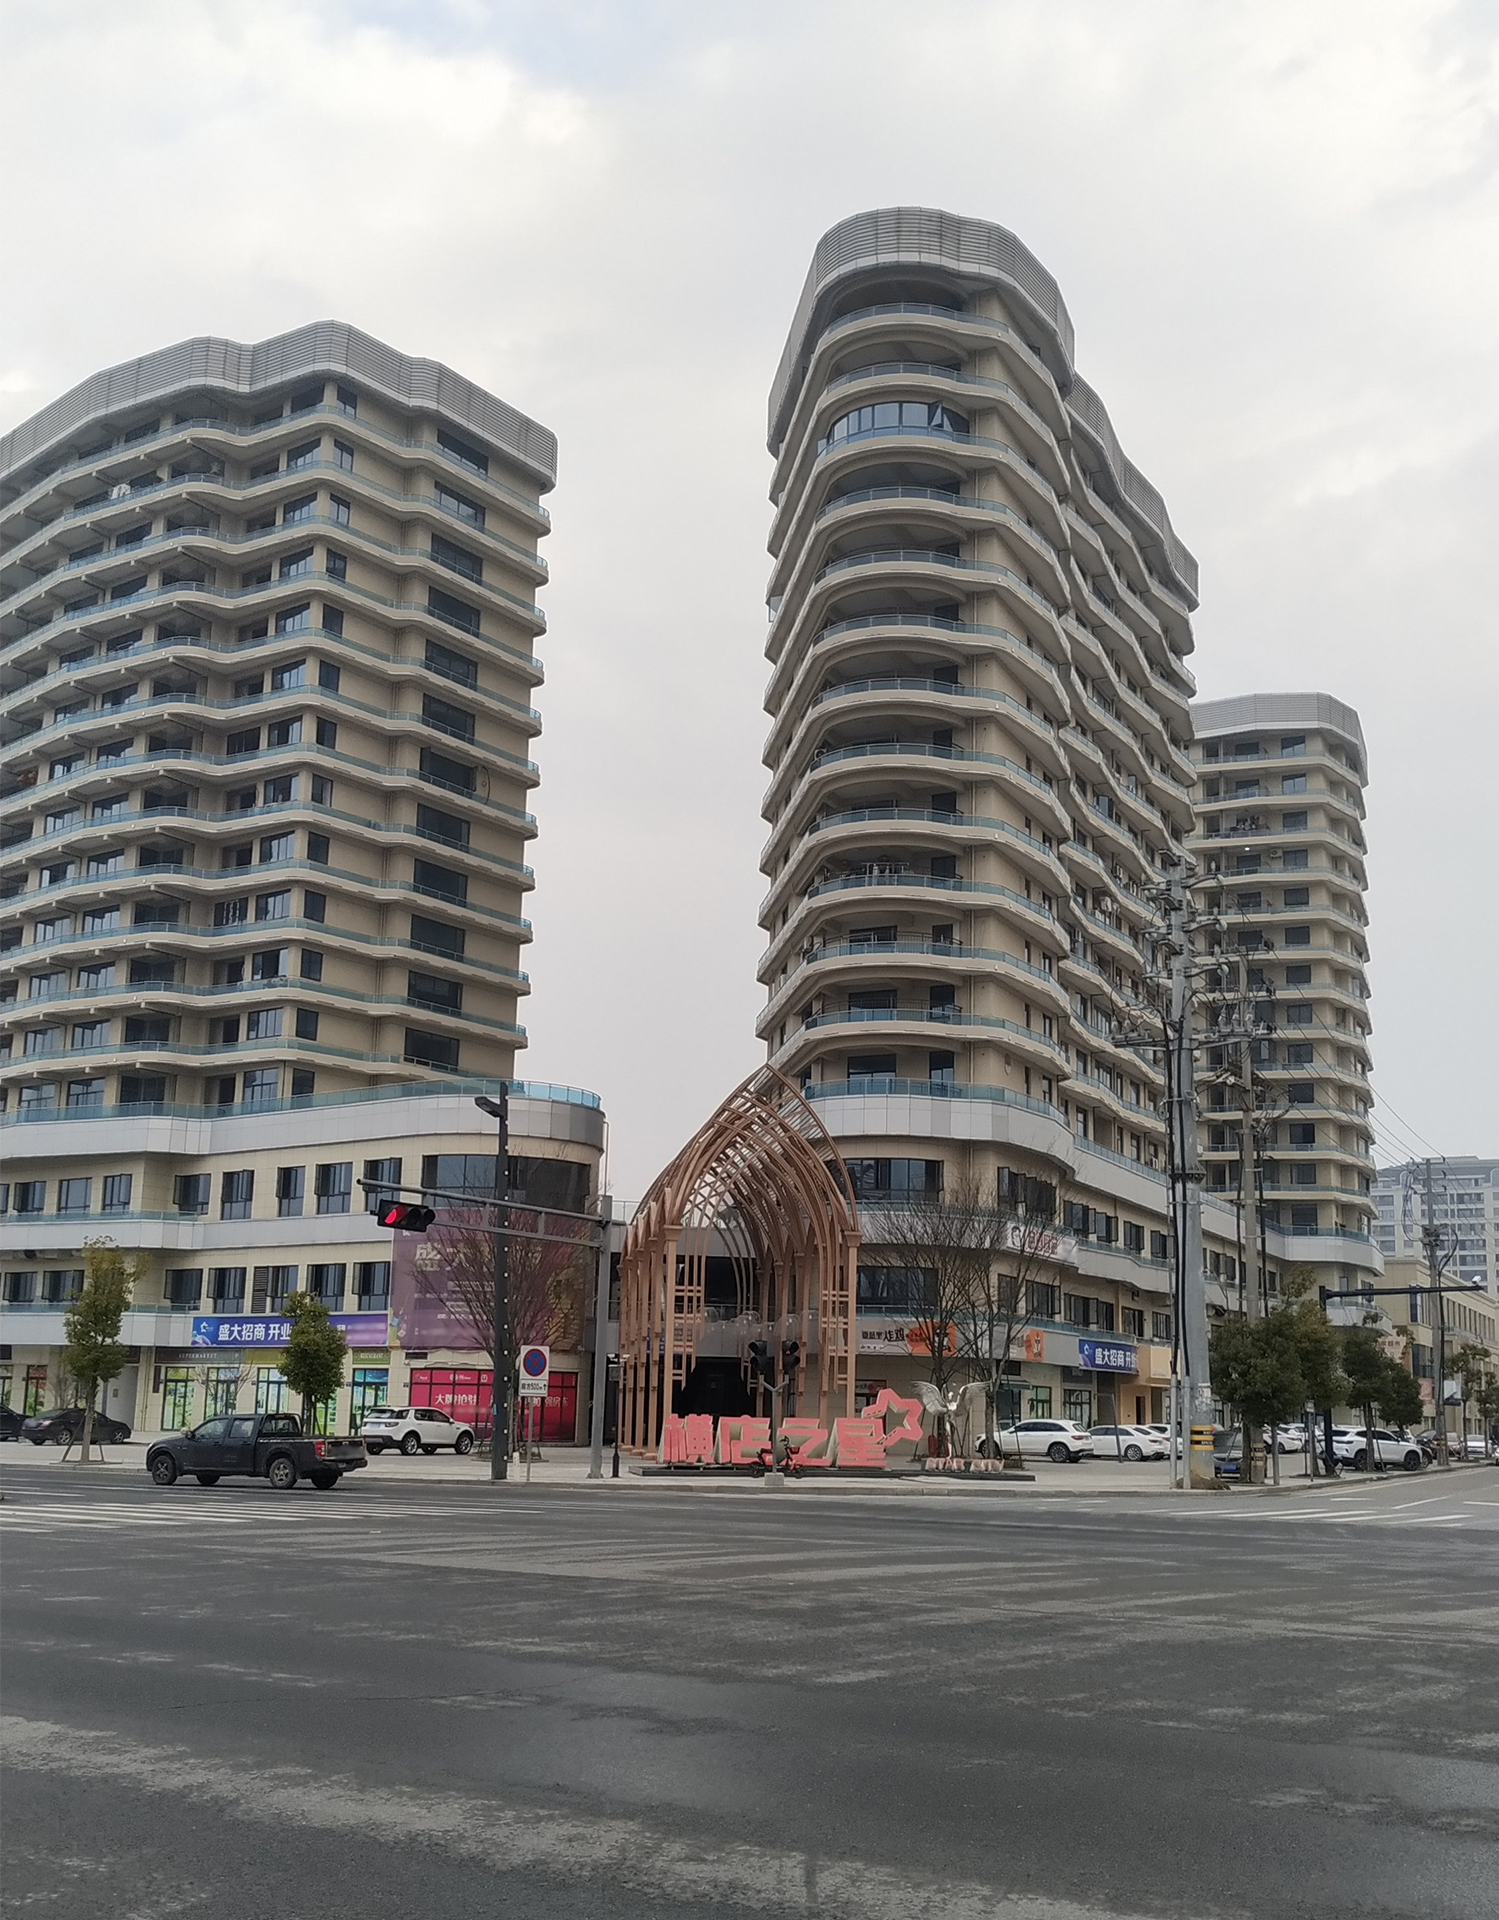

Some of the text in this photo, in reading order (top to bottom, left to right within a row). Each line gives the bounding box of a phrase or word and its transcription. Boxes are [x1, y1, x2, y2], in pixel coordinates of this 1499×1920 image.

[217, 1322, 266, 1341] 盛大招商
[1094, 1347, 1125, 1367] 盛大招商
[657, 1413, 888, 1467] 横店之星
[925, 1457, 965, 1472] STAR
